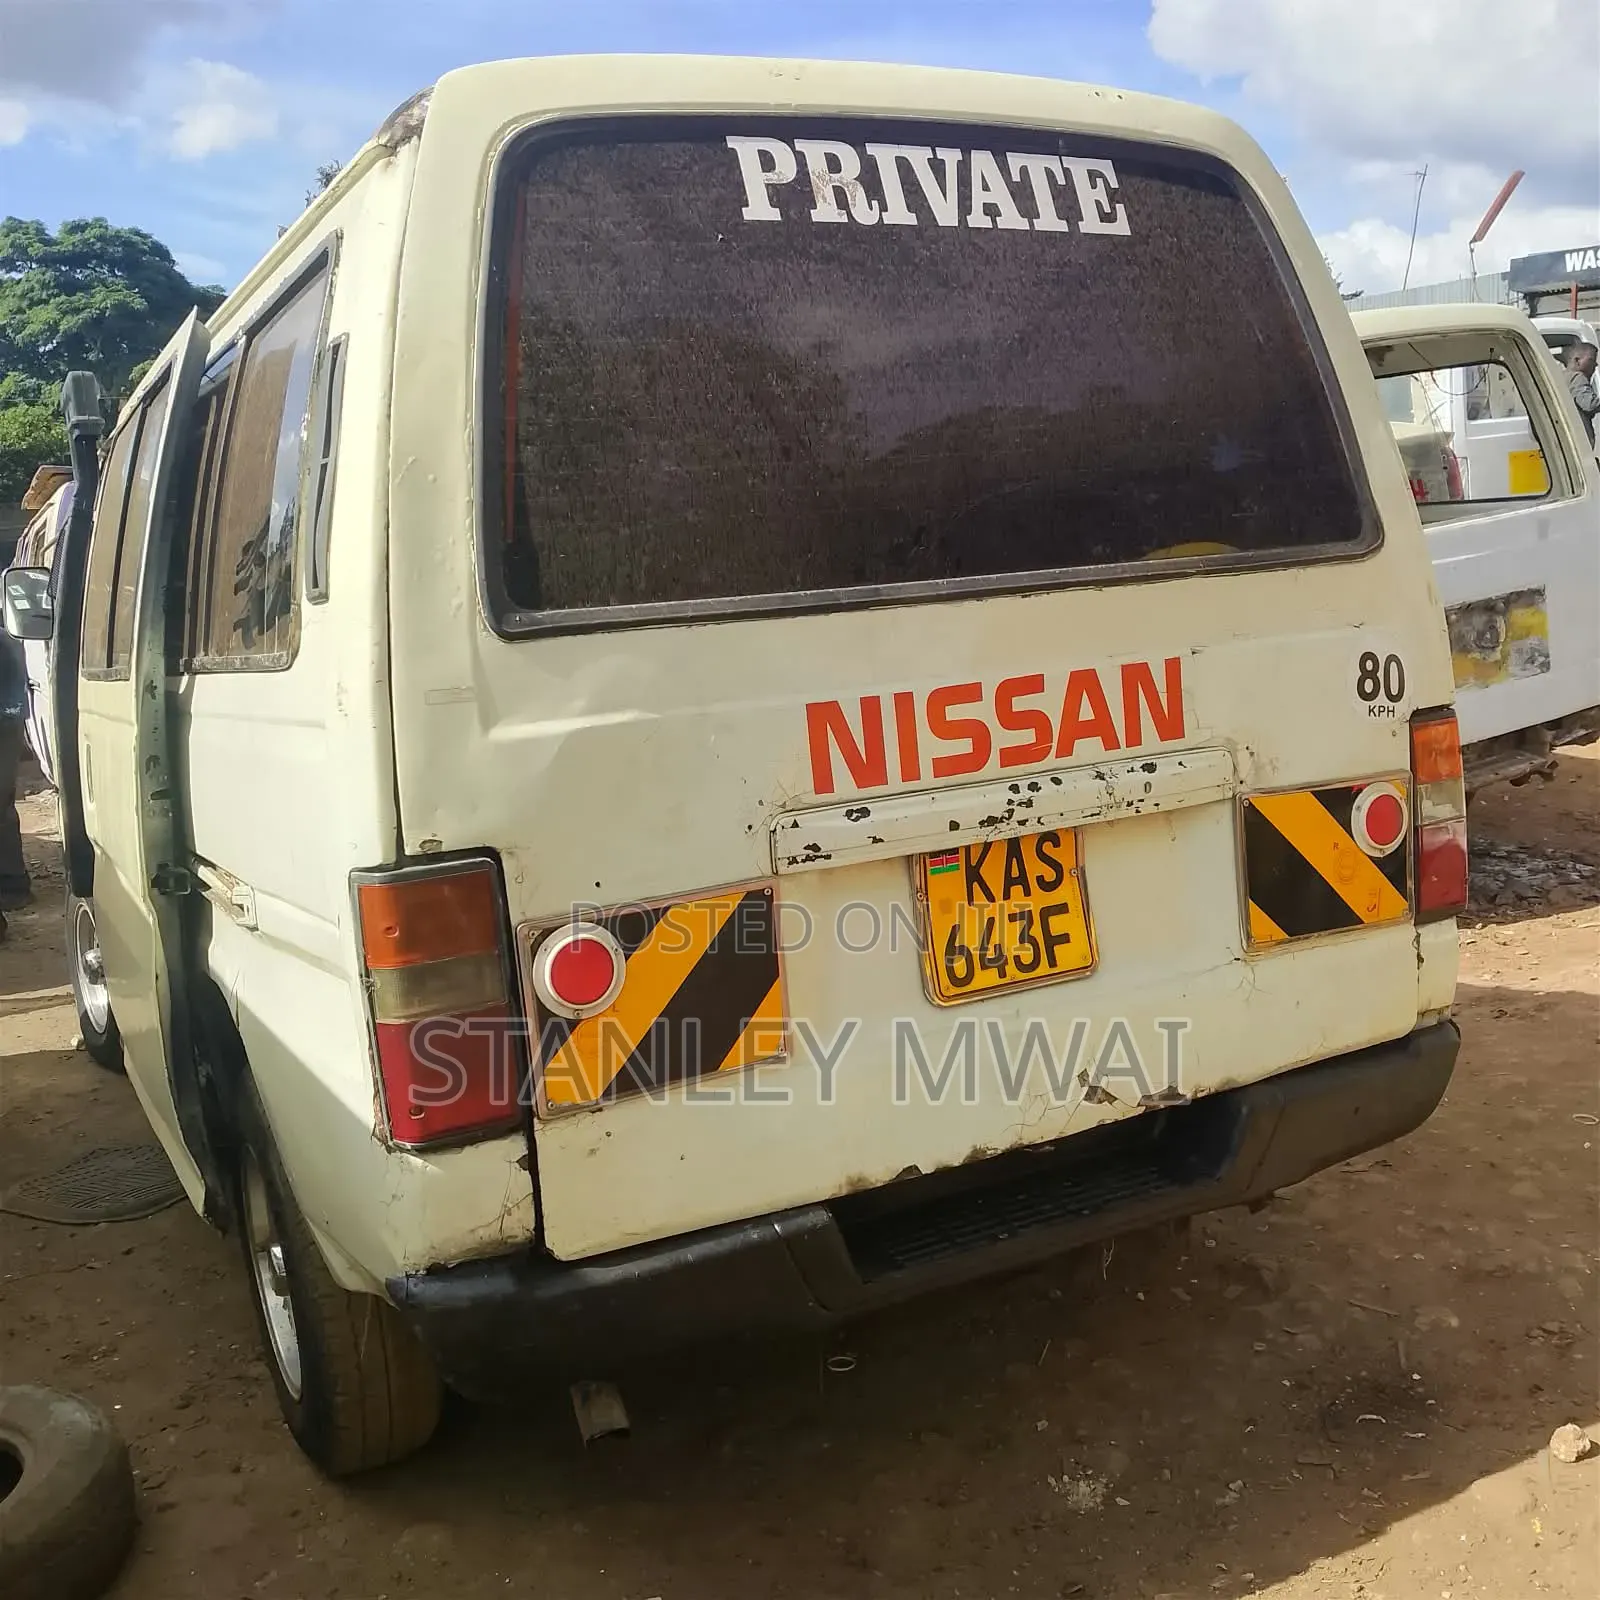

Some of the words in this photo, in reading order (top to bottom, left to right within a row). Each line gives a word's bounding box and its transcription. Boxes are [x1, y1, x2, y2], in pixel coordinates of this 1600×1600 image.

[726, 136, 1131, 235] PRIVATE
[1565, 249, 1600, 272] WA
[1357, 651, 1405, 702] 80
[1368, 704, 1395, 718] KPH
[806, 657, 1185, 795] NISSAN
[964, 831, 1064, 906] KAS
[944, 902, 1071, 988] 643F
